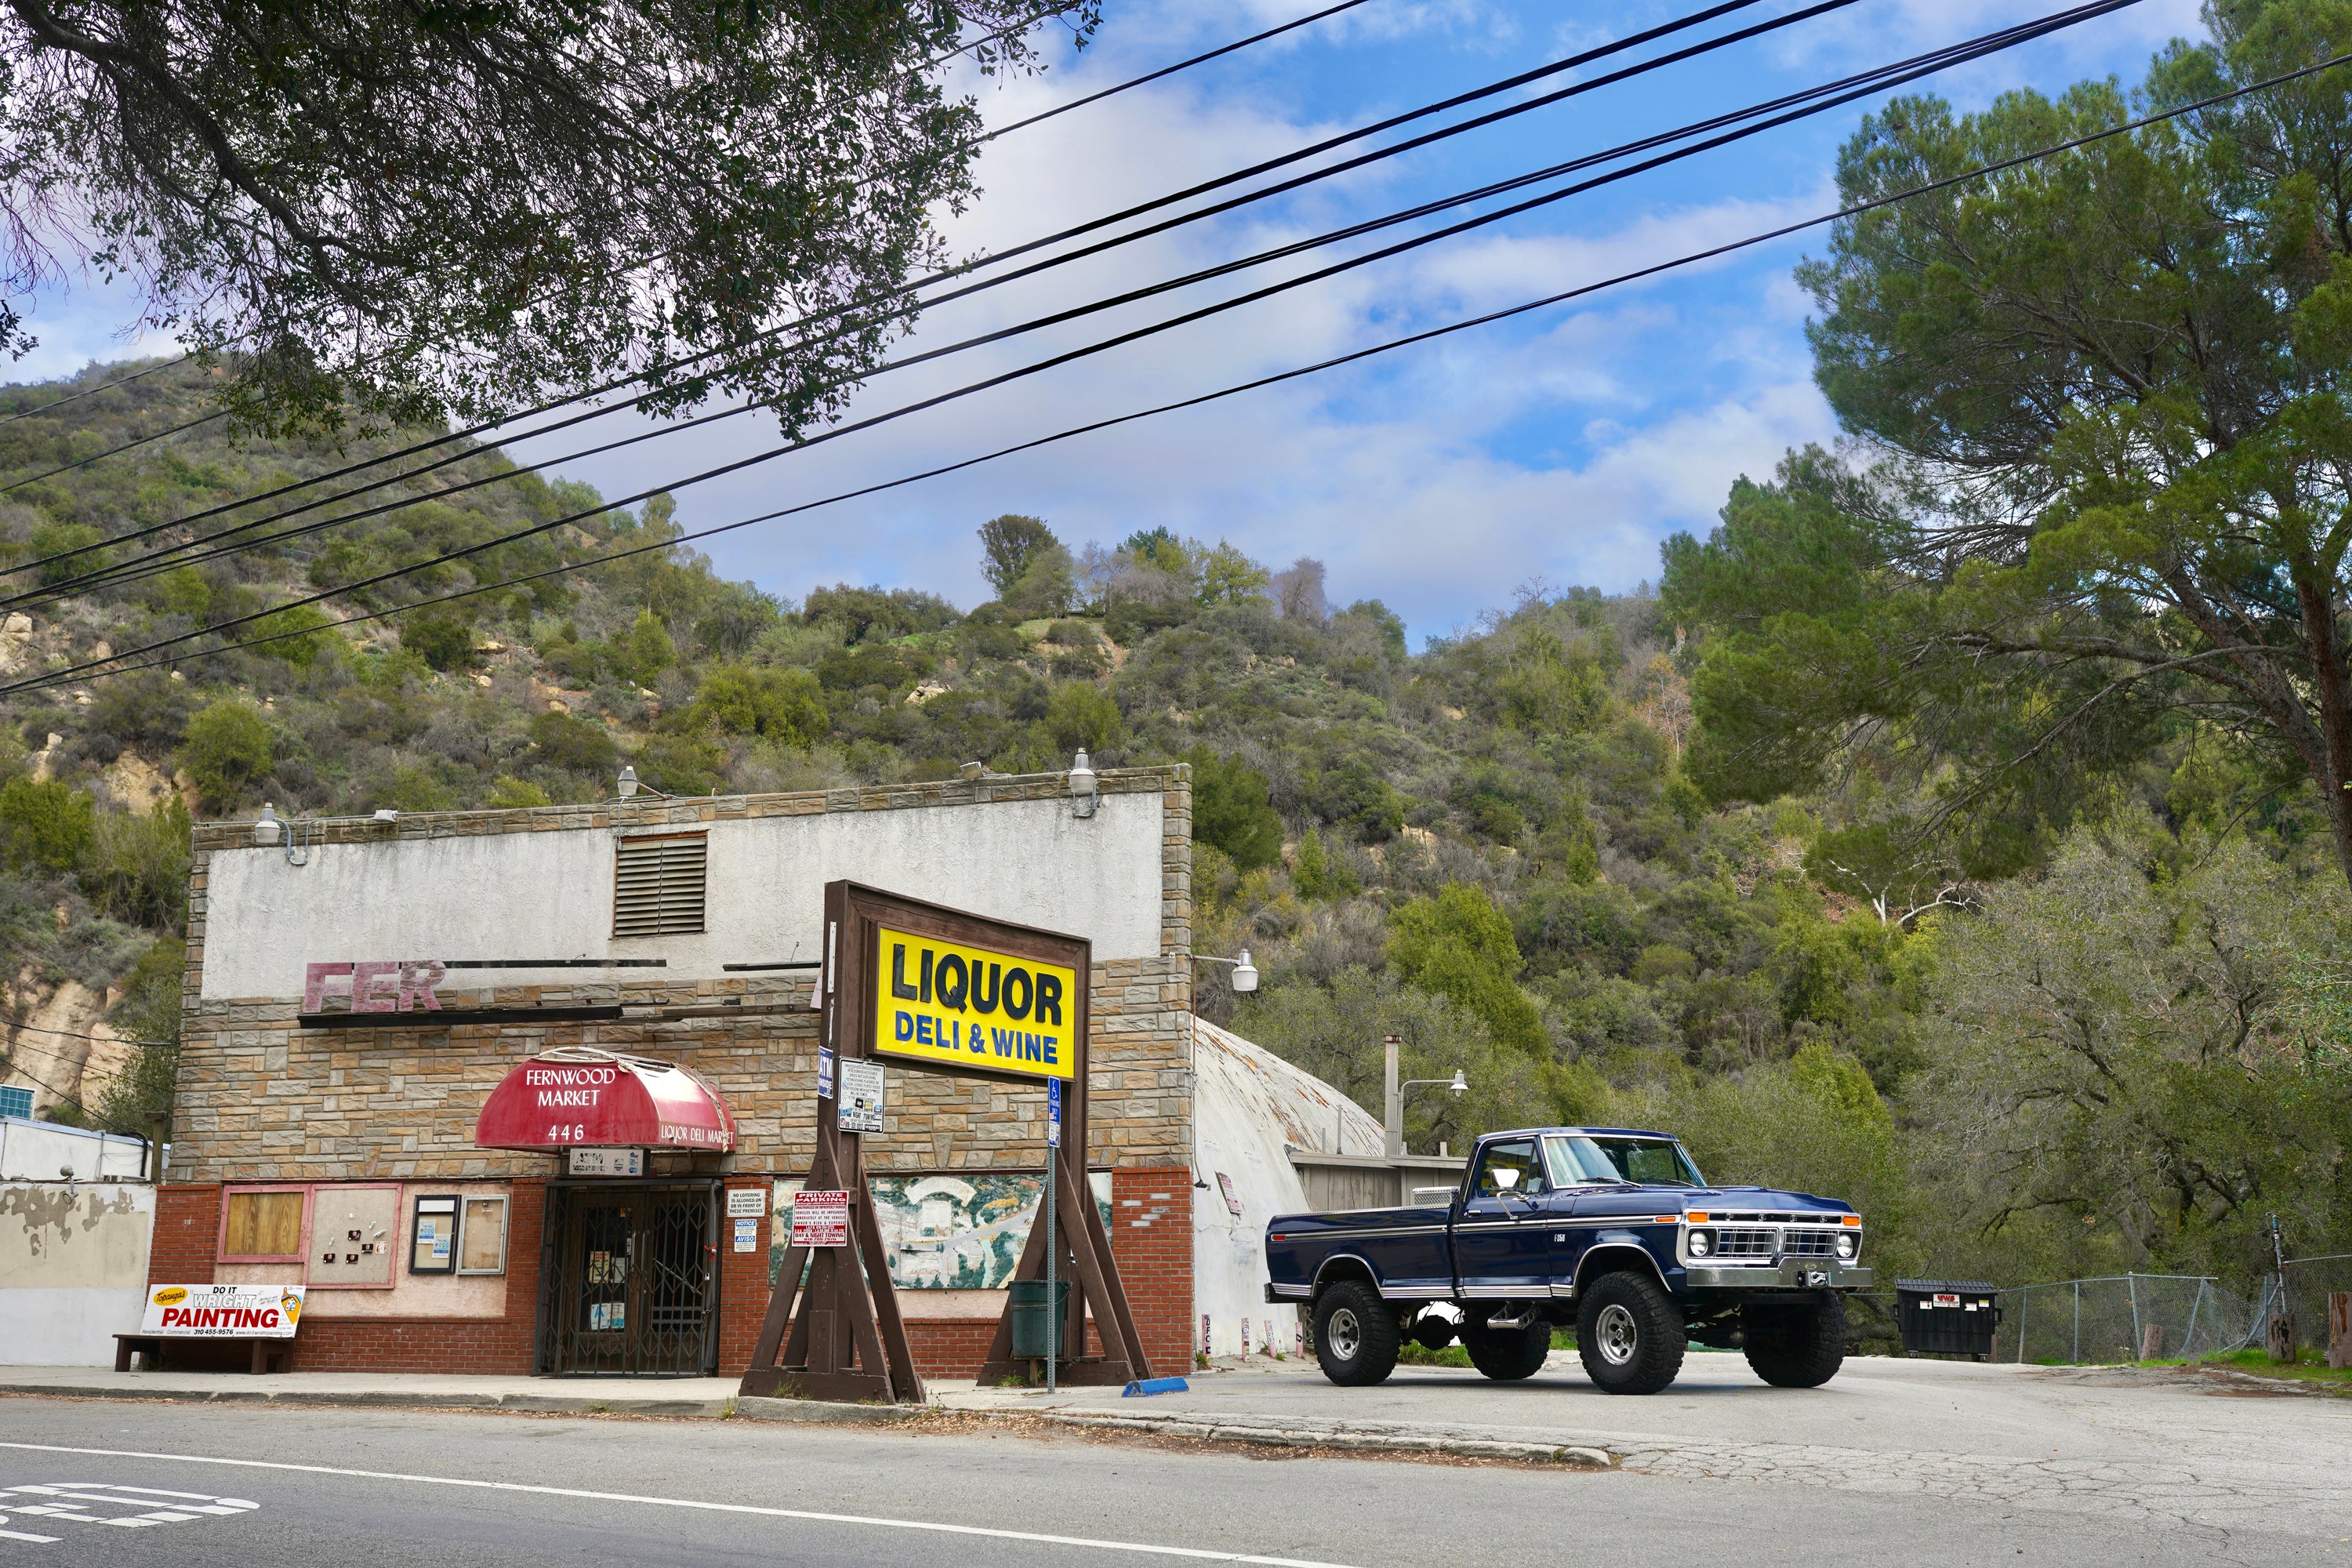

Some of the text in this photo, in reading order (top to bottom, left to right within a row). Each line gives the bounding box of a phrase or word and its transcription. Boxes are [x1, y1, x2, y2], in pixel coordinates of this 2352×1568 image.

[303, 960, 446, 1013] FER
[892, 943, 1062, 1026] LIQUOR
[895, 1011, 1058, 1065] DELI & WINE
[819, 1055, 833, 1079] ATM
[526, 1069, 615, 1086] FERNWOOD
[819, 1078, 833, 1090] INSIDE
[538, 1090, 600, 1106] MARKET
[549, 1124, 584, 1141] 446
[661, 1124, 688, 1140] LIQUOR
[691, 1127, 705, 1142] DELI
[156, 1290, 186, 1304] Topanga's
[161, 1308, 279, 1328] PAINTING
